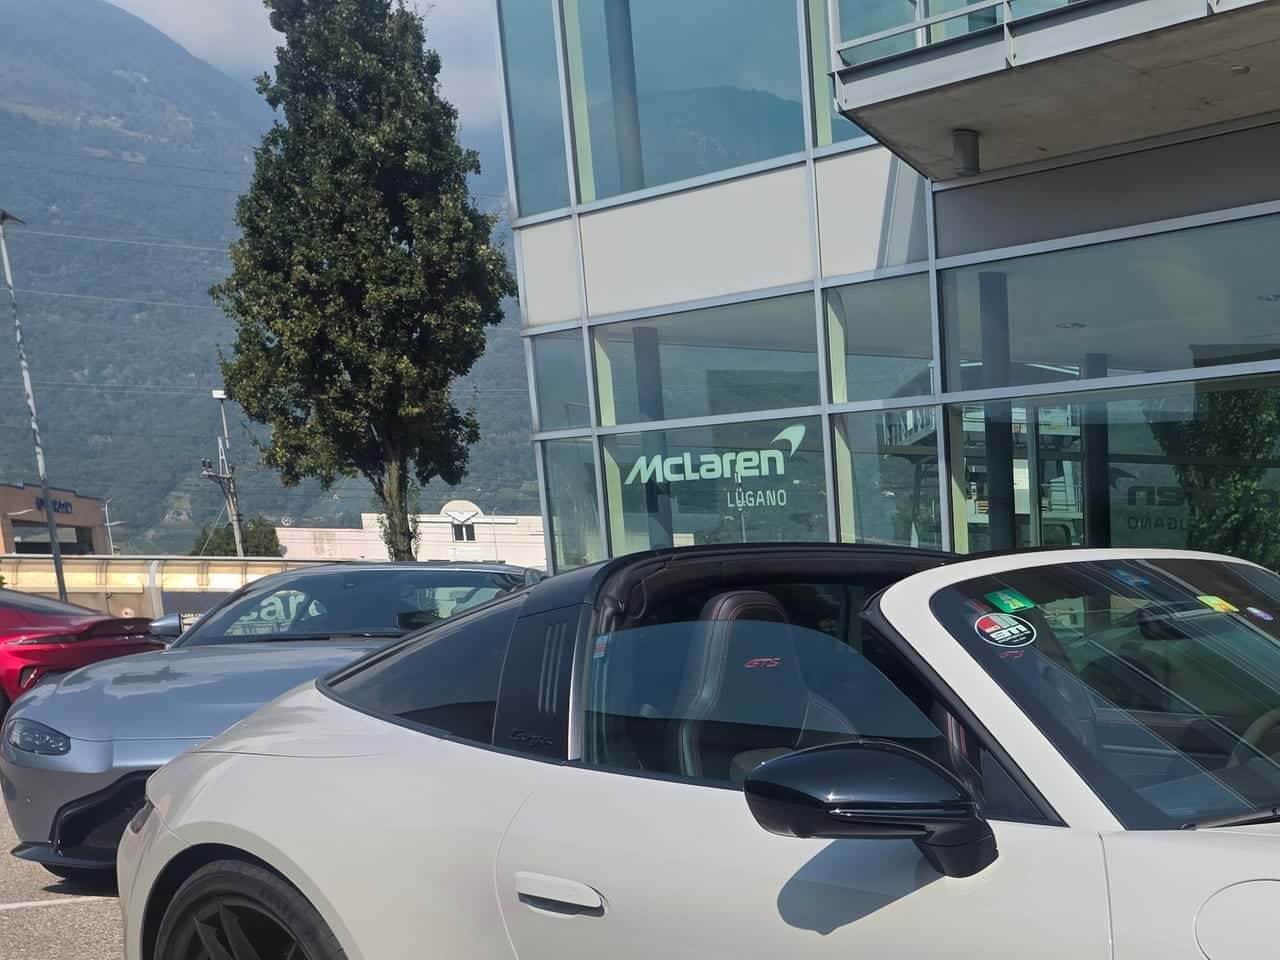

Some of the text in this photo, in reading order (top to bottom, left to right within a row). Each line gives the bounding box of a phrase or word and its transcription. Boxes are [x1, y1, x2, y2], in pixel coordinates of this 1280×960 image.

[624, 450, 786, 485] McLaren
[726, 489, 787, 508] LUGANO
[744, 657, 781, 668] GTS
